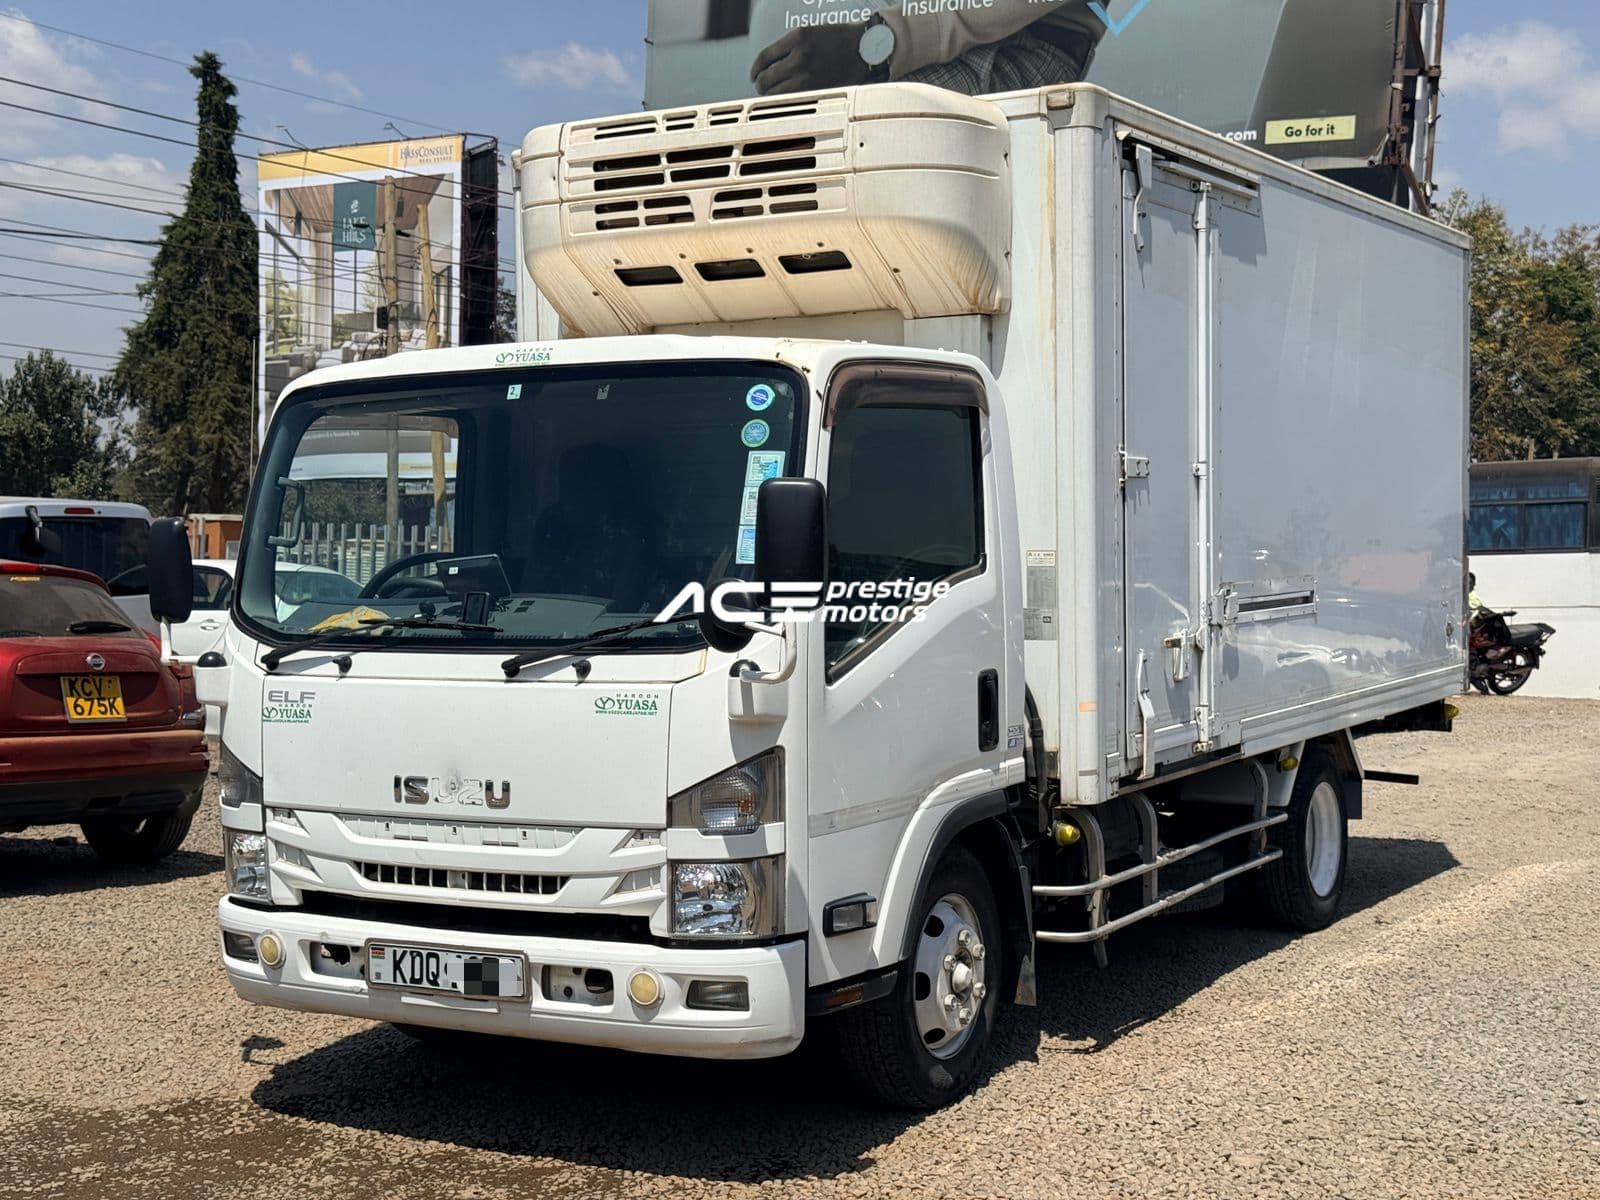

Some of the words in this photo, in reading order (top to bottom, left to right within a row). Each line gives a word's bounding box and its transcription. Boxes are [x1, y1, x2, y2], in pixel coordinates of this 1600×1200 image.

[902, 0, 994, 16] Insurance
[785, 7, 872, 29] Insurance
[1285, 126, 1302, 137] Go
[1305, 125, 1323, 137] for
[1326, 123, 1336, 135] it
[515, 351, 551, 362] YUASA
[67, 677, 103, 697] KCV
[268, 690, 316, 703] ELF
[616, 699, 658, 710] YUASA
[73, 697, 121, 716] 675K
[279, 708, 312, 718] YUASA
[394, 775, 511, 809] ISUZU
[392, 949, 440, 987] KDQ
